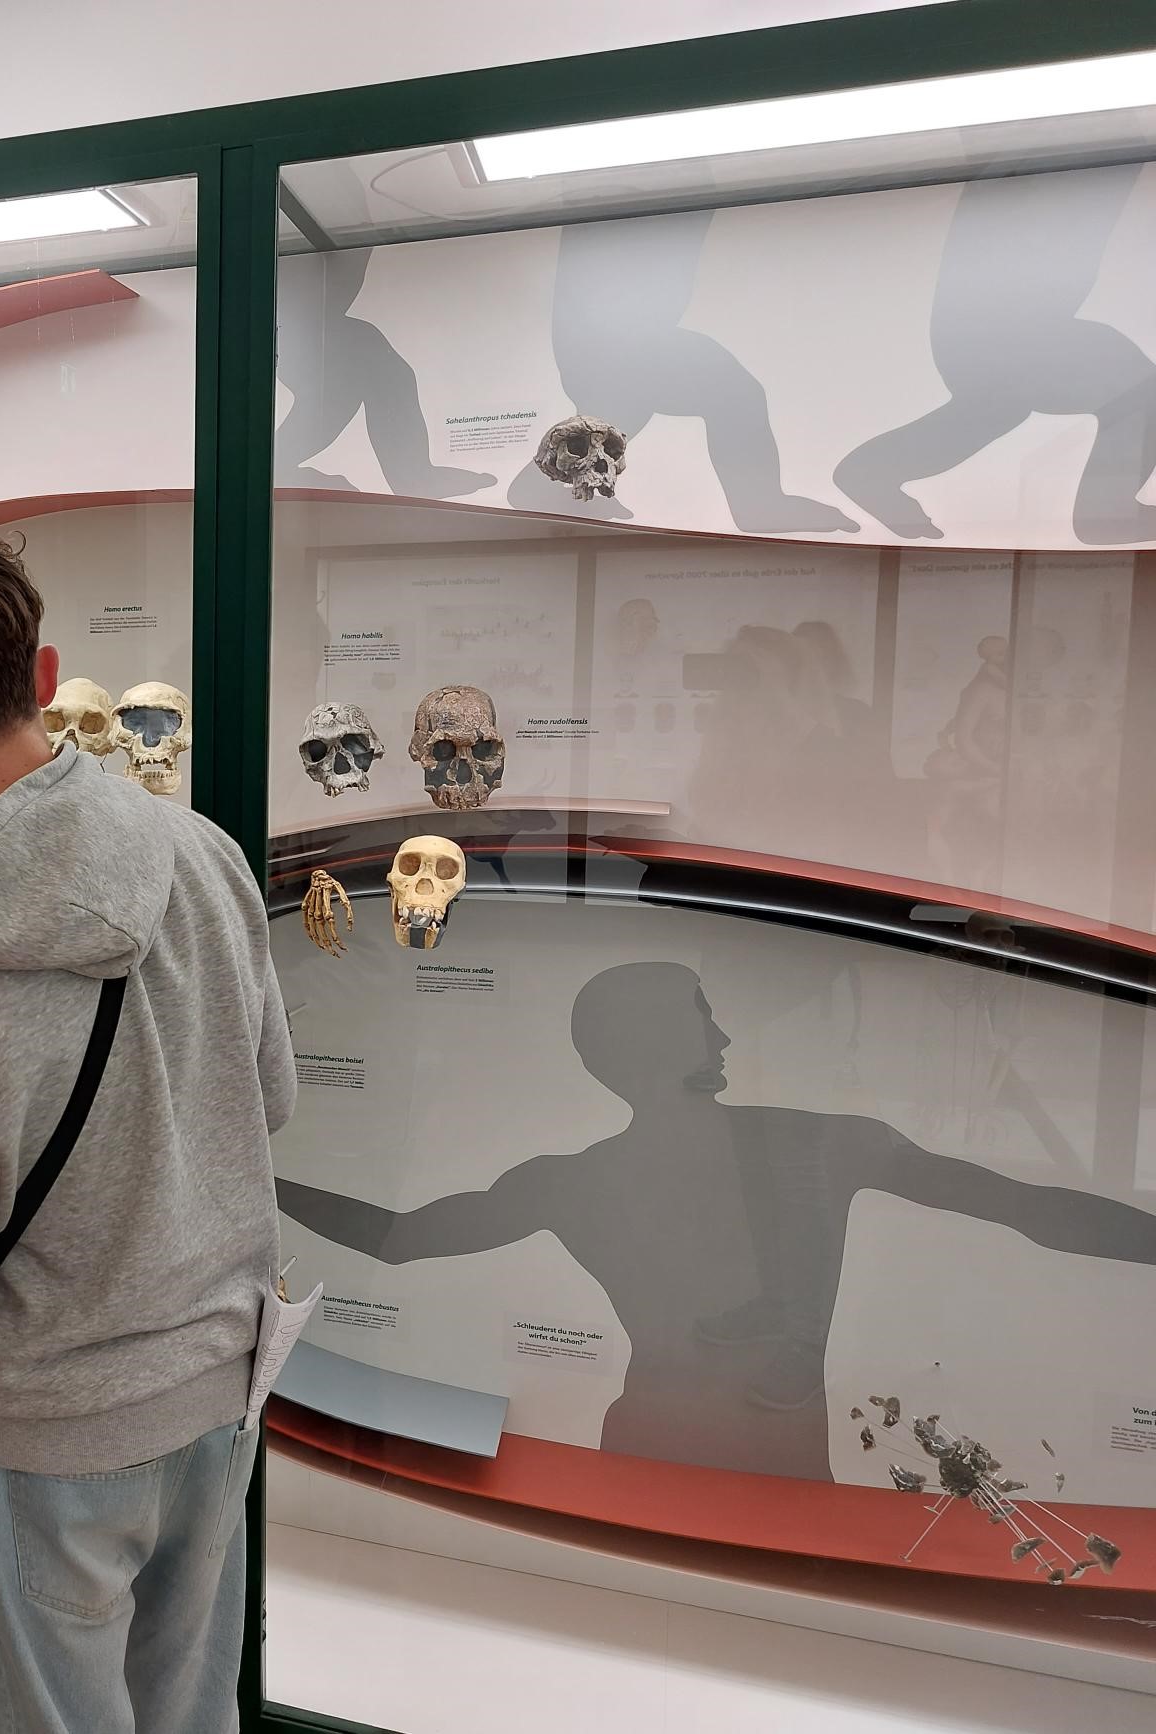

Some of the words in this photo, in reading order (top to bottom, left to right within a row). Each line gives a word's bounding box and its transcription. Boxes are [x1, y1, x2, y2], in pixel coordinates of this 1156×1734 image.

[445, 415, 499, 425] Sahelanthropus
[500, 411, 537, 420] tchadensis
[341, 632, 361, 640] Homo
[361, 631, 384, 639] habilis
[527, 718, 549, 726] Homo
[549, 717, 588, 726] rudolfensis
[416, 964, 471, 974] Australopithecus
[471, 967, 494, 975] sediba
[294, 1052, 345, 1063] Australopithecus
[321, 1295, 372, 1309] Australopithecus
[372, 1303, 400, 1312] robustus
[513, 1321, 557, 1334] „Schleuderst
[557, 1327, 567, 1335] du
[568, 1329, 585, 1338] noch
[528, 1332, 548, 1341] wirfst
[549, 1335, 559, 1343] du
[1132, 1407, 1150, 1416] Von
[1133, 1418, 1152, 1426] zum
